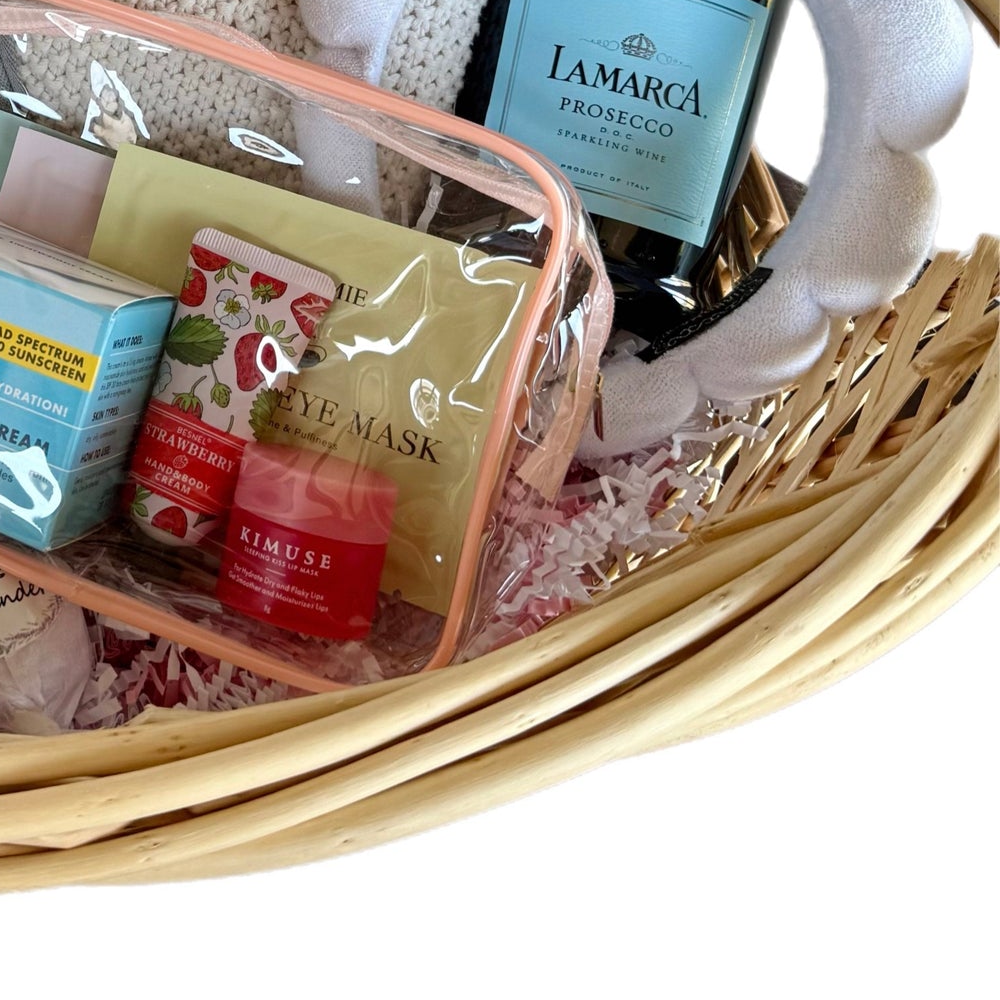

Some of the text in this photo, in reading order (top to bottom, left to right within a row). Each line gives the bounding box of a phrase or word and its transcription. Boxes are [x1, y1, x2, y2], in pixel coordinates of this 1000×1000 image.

[559, 97, 673, 137] PROSECCO
[557, 128, 667, 163] SPARKLING WINE
[560, 163, 605, 179] PRODUCT
[626, 180, 650, 192] ITALY
[8, 345, 87, 383] SUNSCREEN
[16, 333, 85, 368] SPECTRUM
[277, 386, 443, 465] EYE MASK
[283, 423, 290, 432] &
[294, 426, 339, 451] Puffiness
[145, 423, 236, 473] STRAWBERRY
[145, 457, 211, 492] HAND&BODY
[155, 473, 191, 495] CREAM
[240, 526, 331, 570] KIMUSE
[244, 545, 319, 577] SLEEPING KISS LIP MASK
[233, 562, 324, 601] For Hydrate Dry and Flaky Lips
[262, 586, 275, 598] and
[315, 602, 329, 612] Lips
